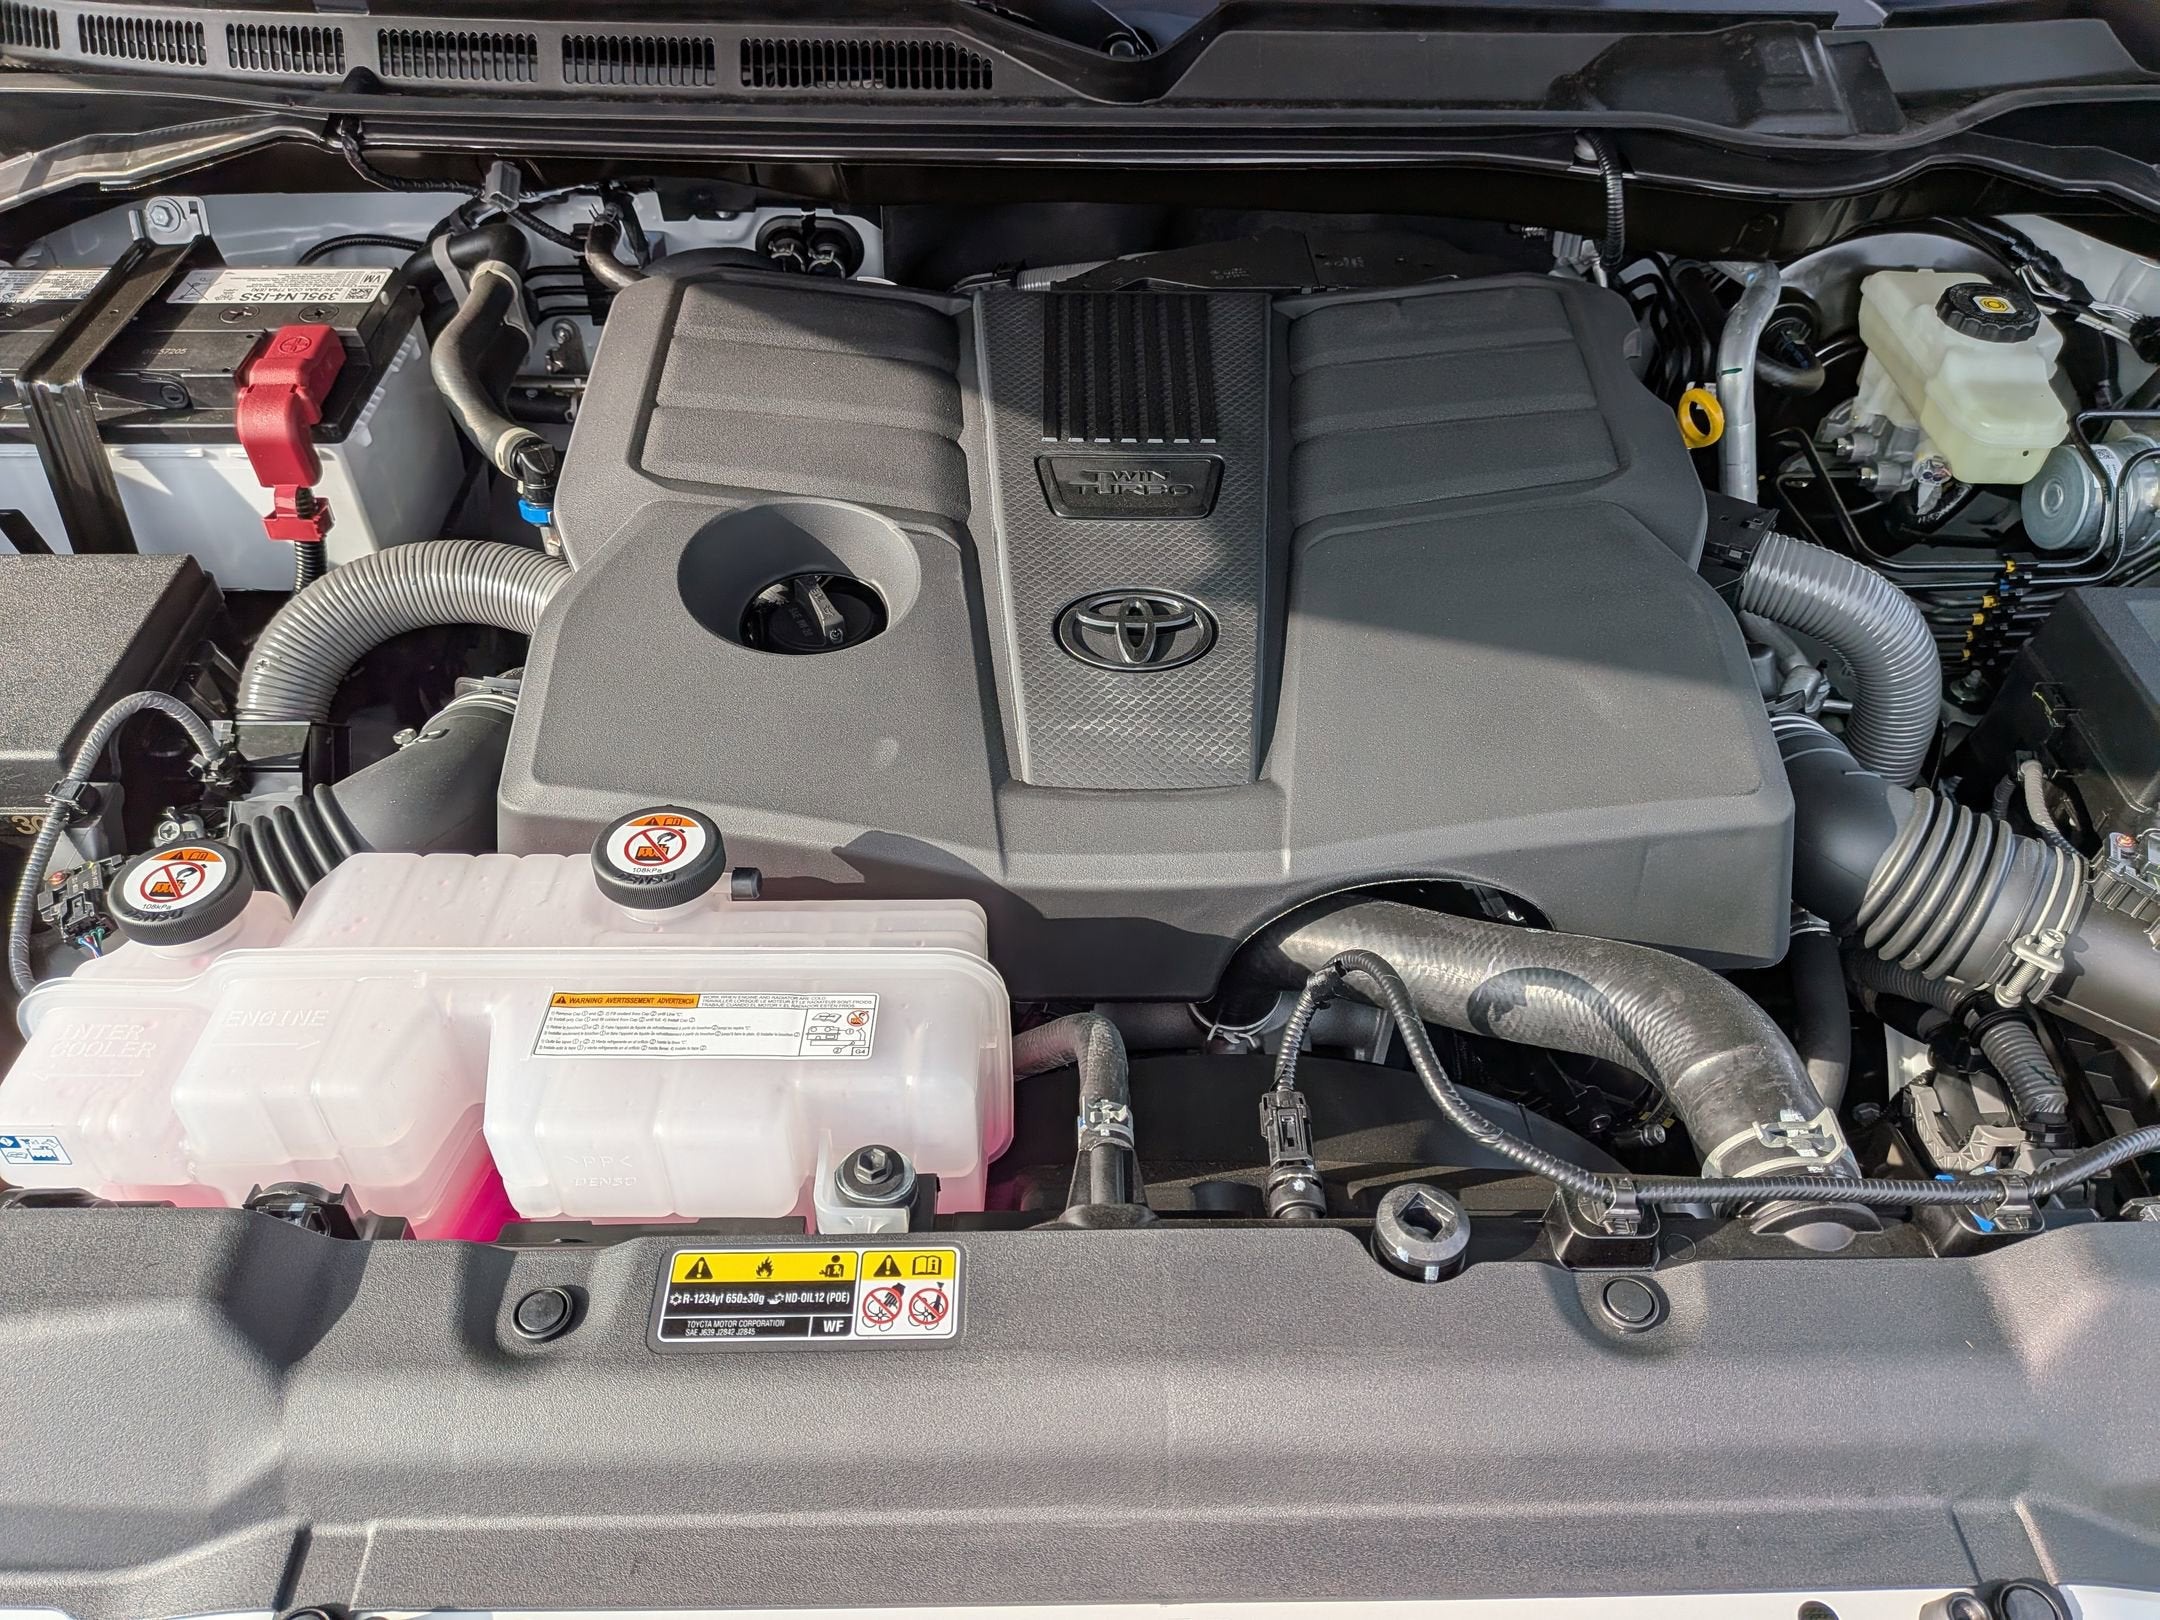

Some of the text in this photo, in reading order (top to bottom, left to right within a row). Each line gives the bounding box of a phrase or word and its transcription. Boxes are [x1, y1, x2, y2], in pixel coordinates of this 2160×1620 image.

[363, 274, 383, 283] VM
[239, 292, 340, 302] 395LN4-ISS
[1080, 469, 1171, 482] TWIN
[1068, 481, 1195, 496] TURBO
[224, 1009, 330, 1027] ENGINE
[62, 1024, 145, 1041] INTER
[51, 1041, 157, 1058] COOLER
[575, 1176, 637, 1187] DENSO
[725, 1292, 765, 1306] 650±30g
[785, 1292, 825, 1303] ND-OIL12
[826, 1291, 850, 1305] (POE)
[712, 1320, 738, 1328] MOTOR
[738, 1319, 785, 1327] CORPORATION
[823, 1320, 845, 1333] WF
[685, 1328, 699, 1336] SAE
